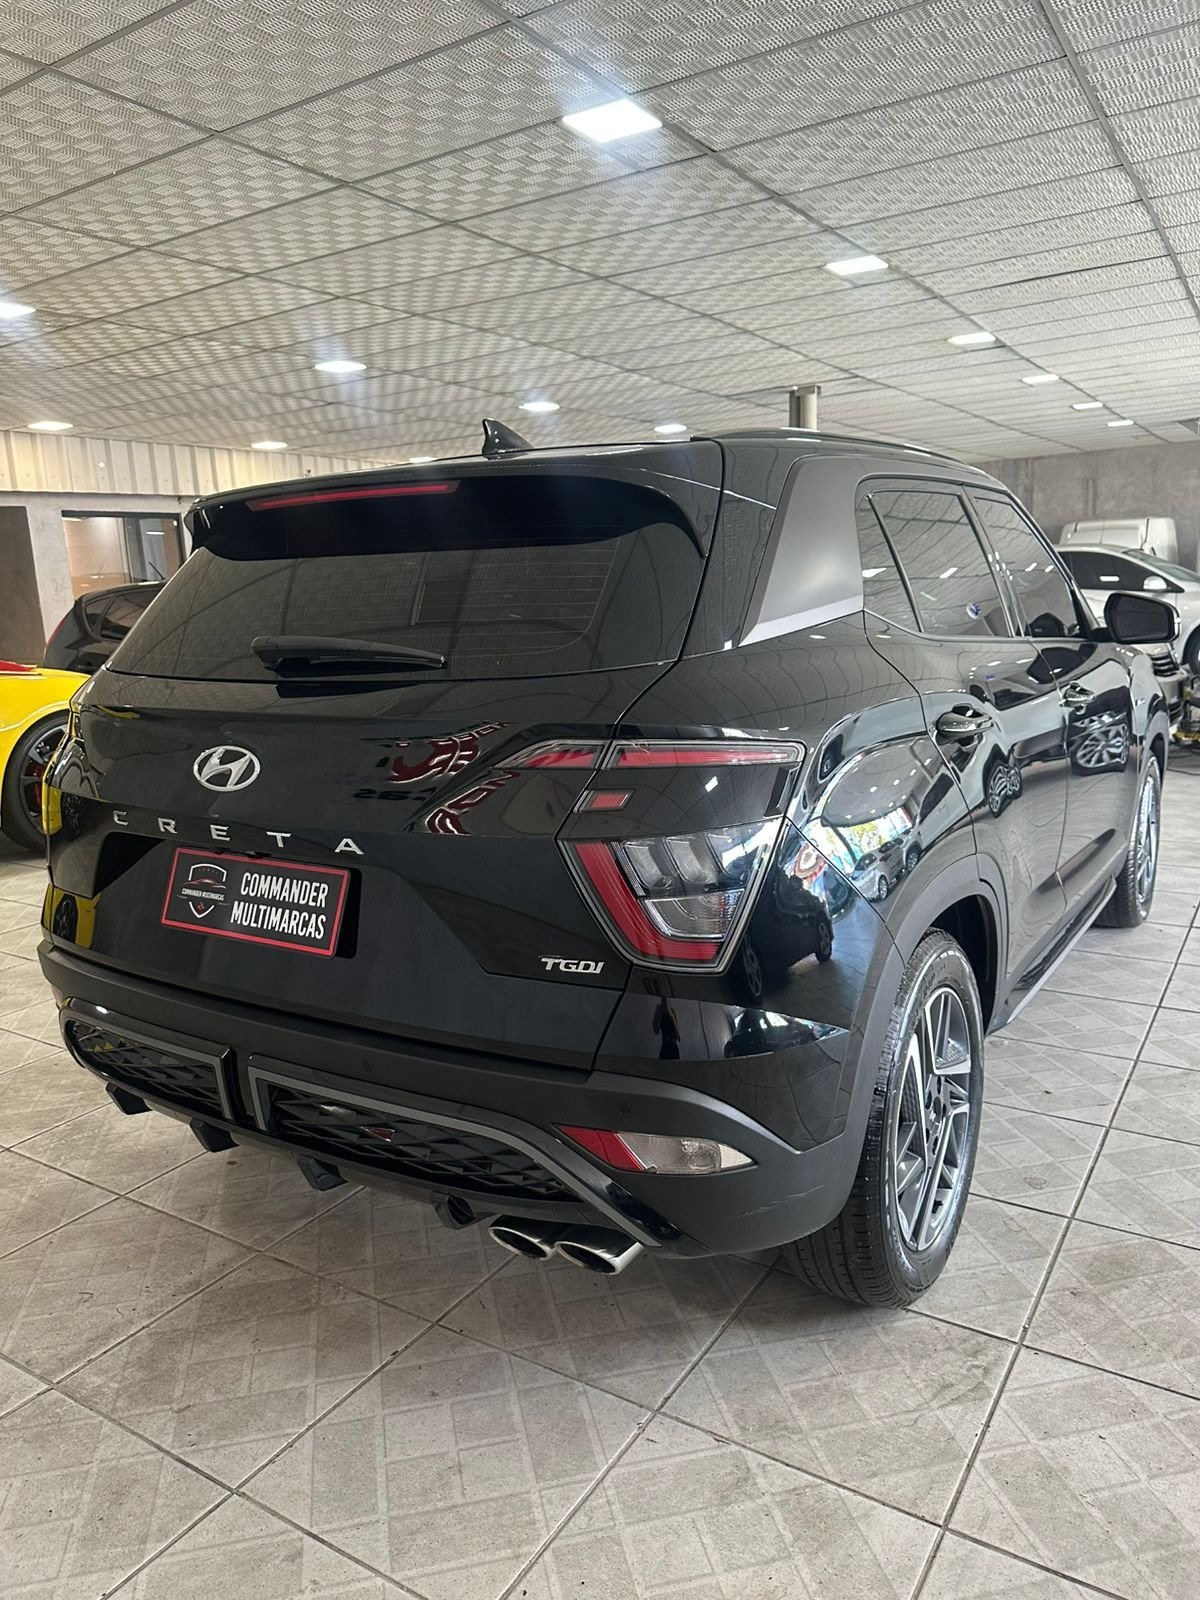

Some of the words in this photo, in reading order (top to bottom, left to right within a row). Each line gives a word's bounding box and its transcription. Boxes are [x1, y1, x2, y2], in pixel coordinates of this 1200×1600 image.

[112, 810, 364, 855] CRETA
[240, 872, 329, 908] COMMANDER
[230, 900, 327, 940] MULTIMARCAS
[541, 957, 605, 974] TGDI
